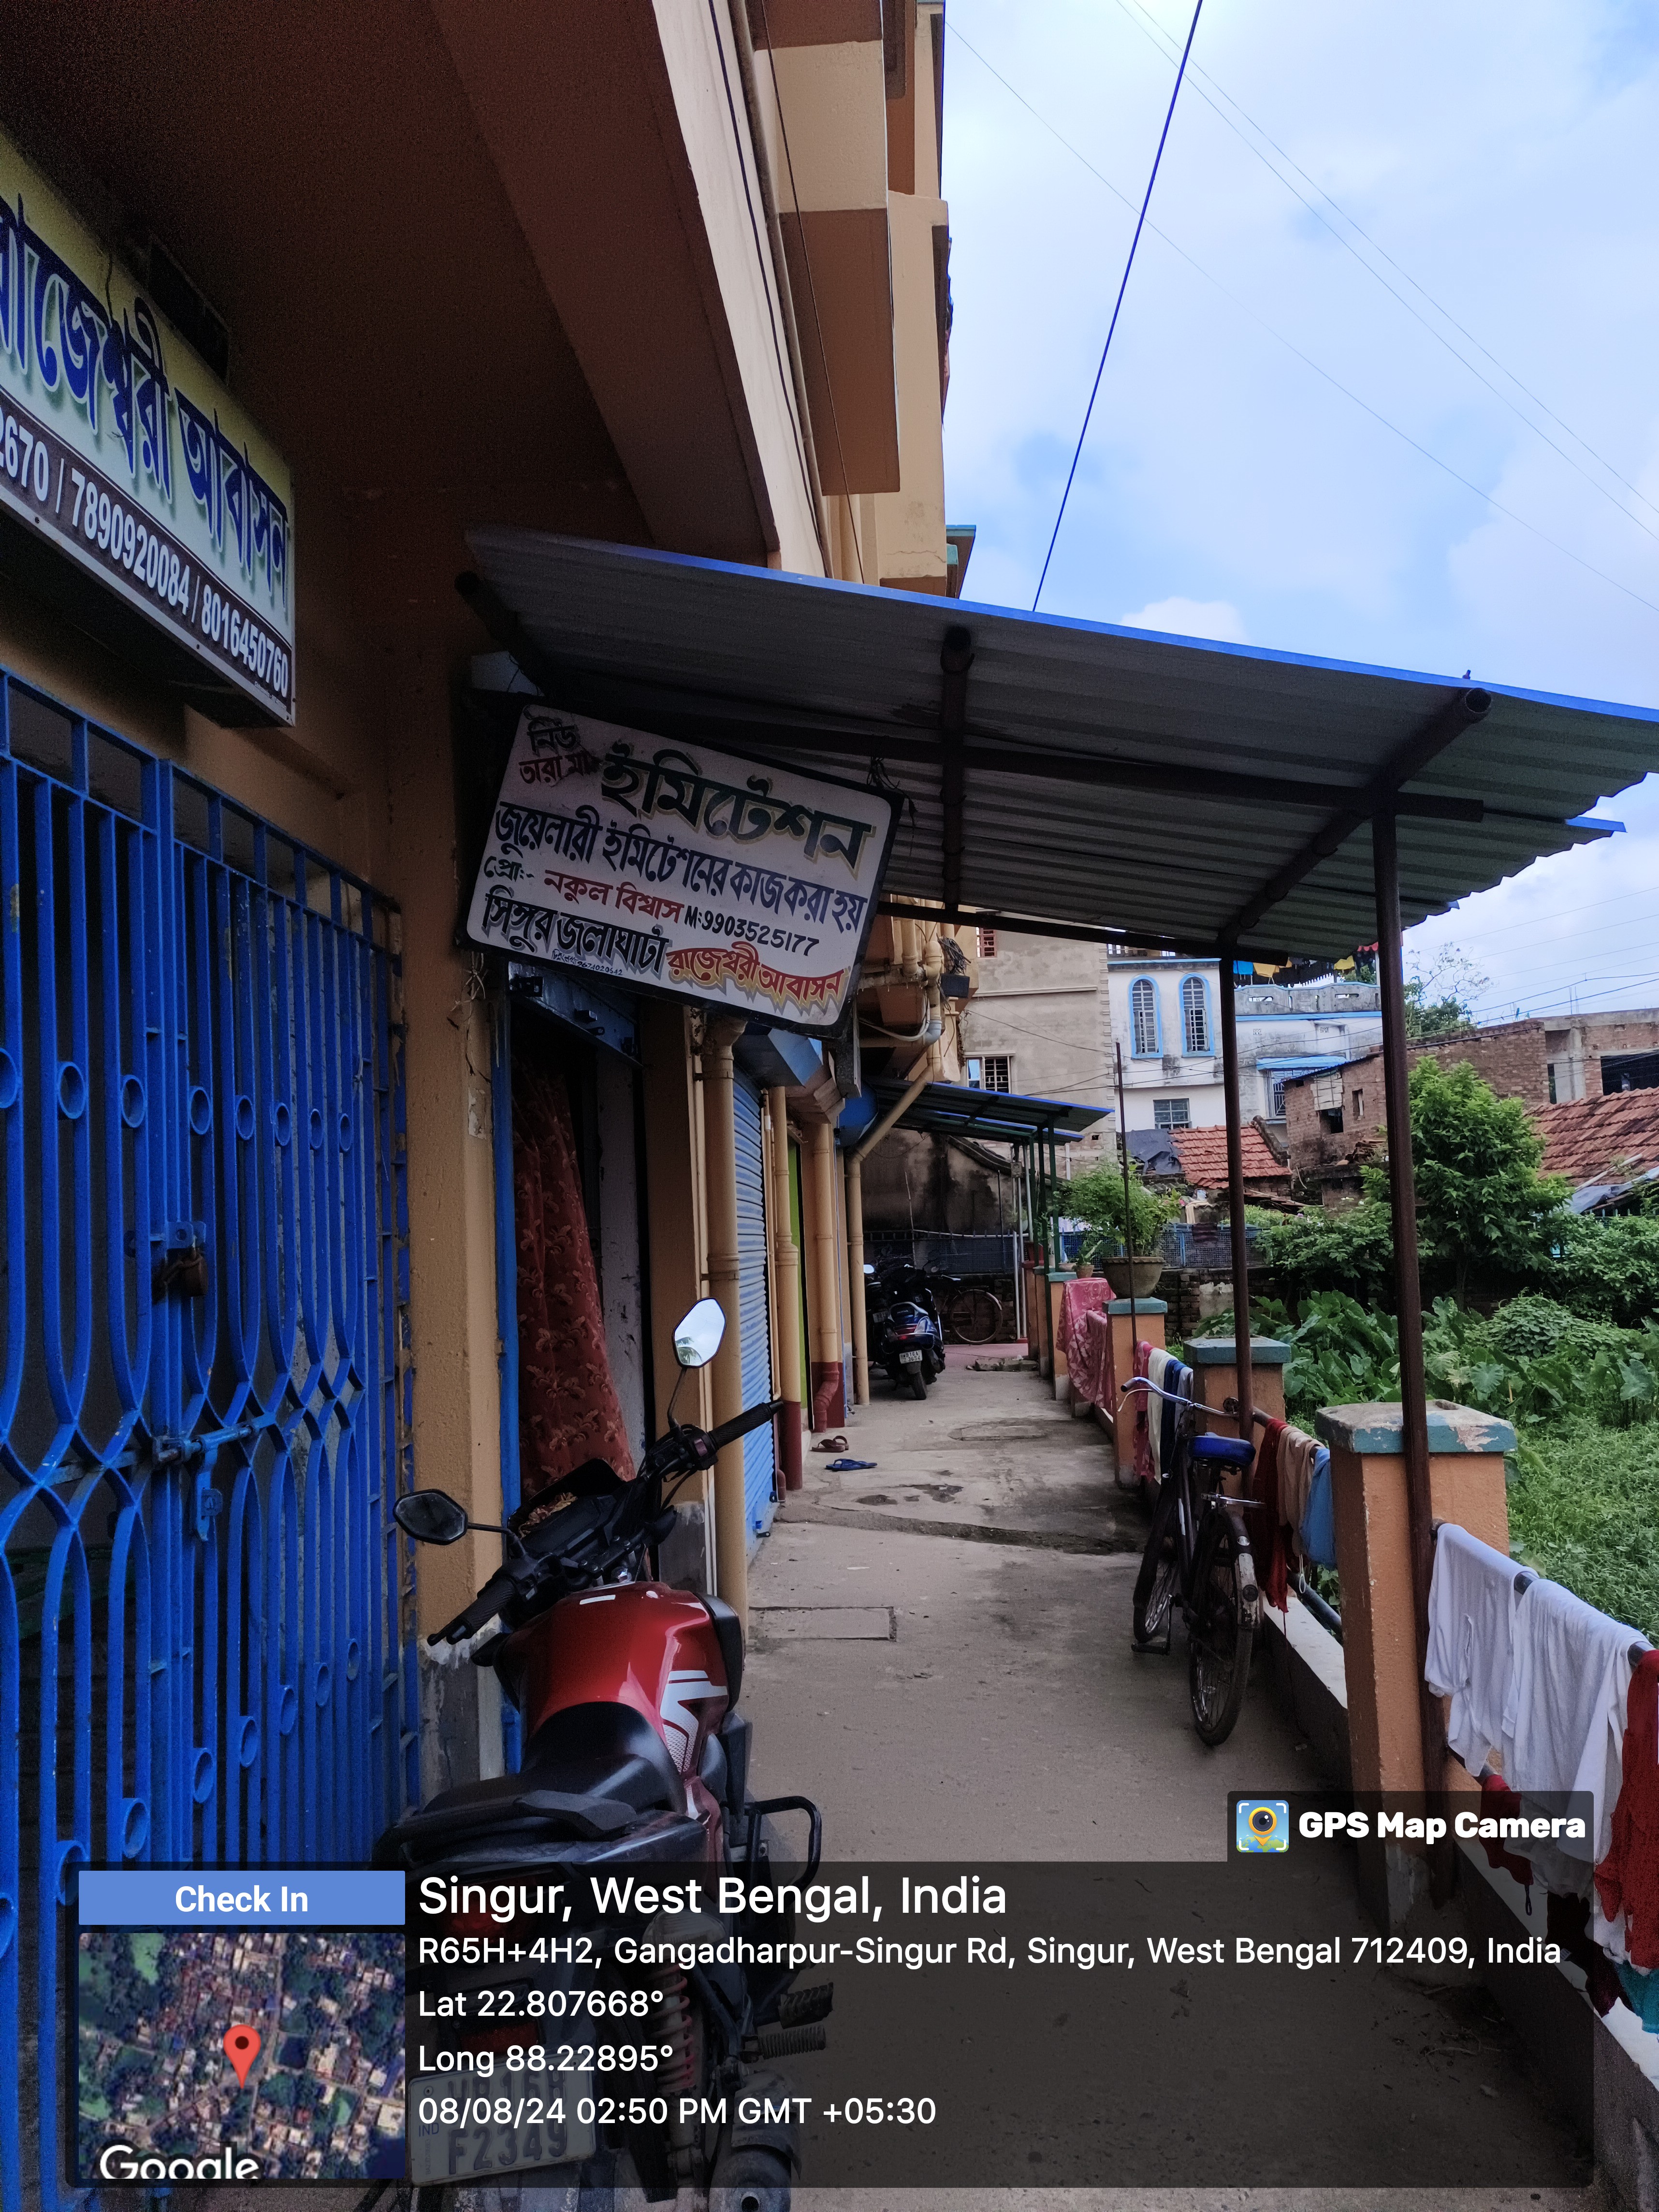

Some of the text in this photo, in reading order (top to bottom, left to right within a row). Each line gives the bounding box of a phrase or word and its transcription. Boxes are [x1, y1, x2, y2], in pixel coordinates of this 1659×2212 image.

[175, 387, 289, 612] আবাসন
[72, 467, 189, 615] 7890920084
[201, 584, 289, 698] 8016450760
[526, 716, 578, 755] নিউ
[601, 740, 873, 870] ইমিটেশন
[544, 870, 613, 904] নকুল
[615, 881, 685, 923] বিশ্বাস
[602, 819, 733, 897] ইমিটেশনের
[730, 861, 787, 914] কাজ
[784, 876, 835, 924] করা
[831, 890, 868, 933] হয়
[666, 941, 845, 1003] রাজেশ্বরী আবাসন
[419, 2123, 439, 2137] IND
[448, 2114, 568, 2174] F2349
